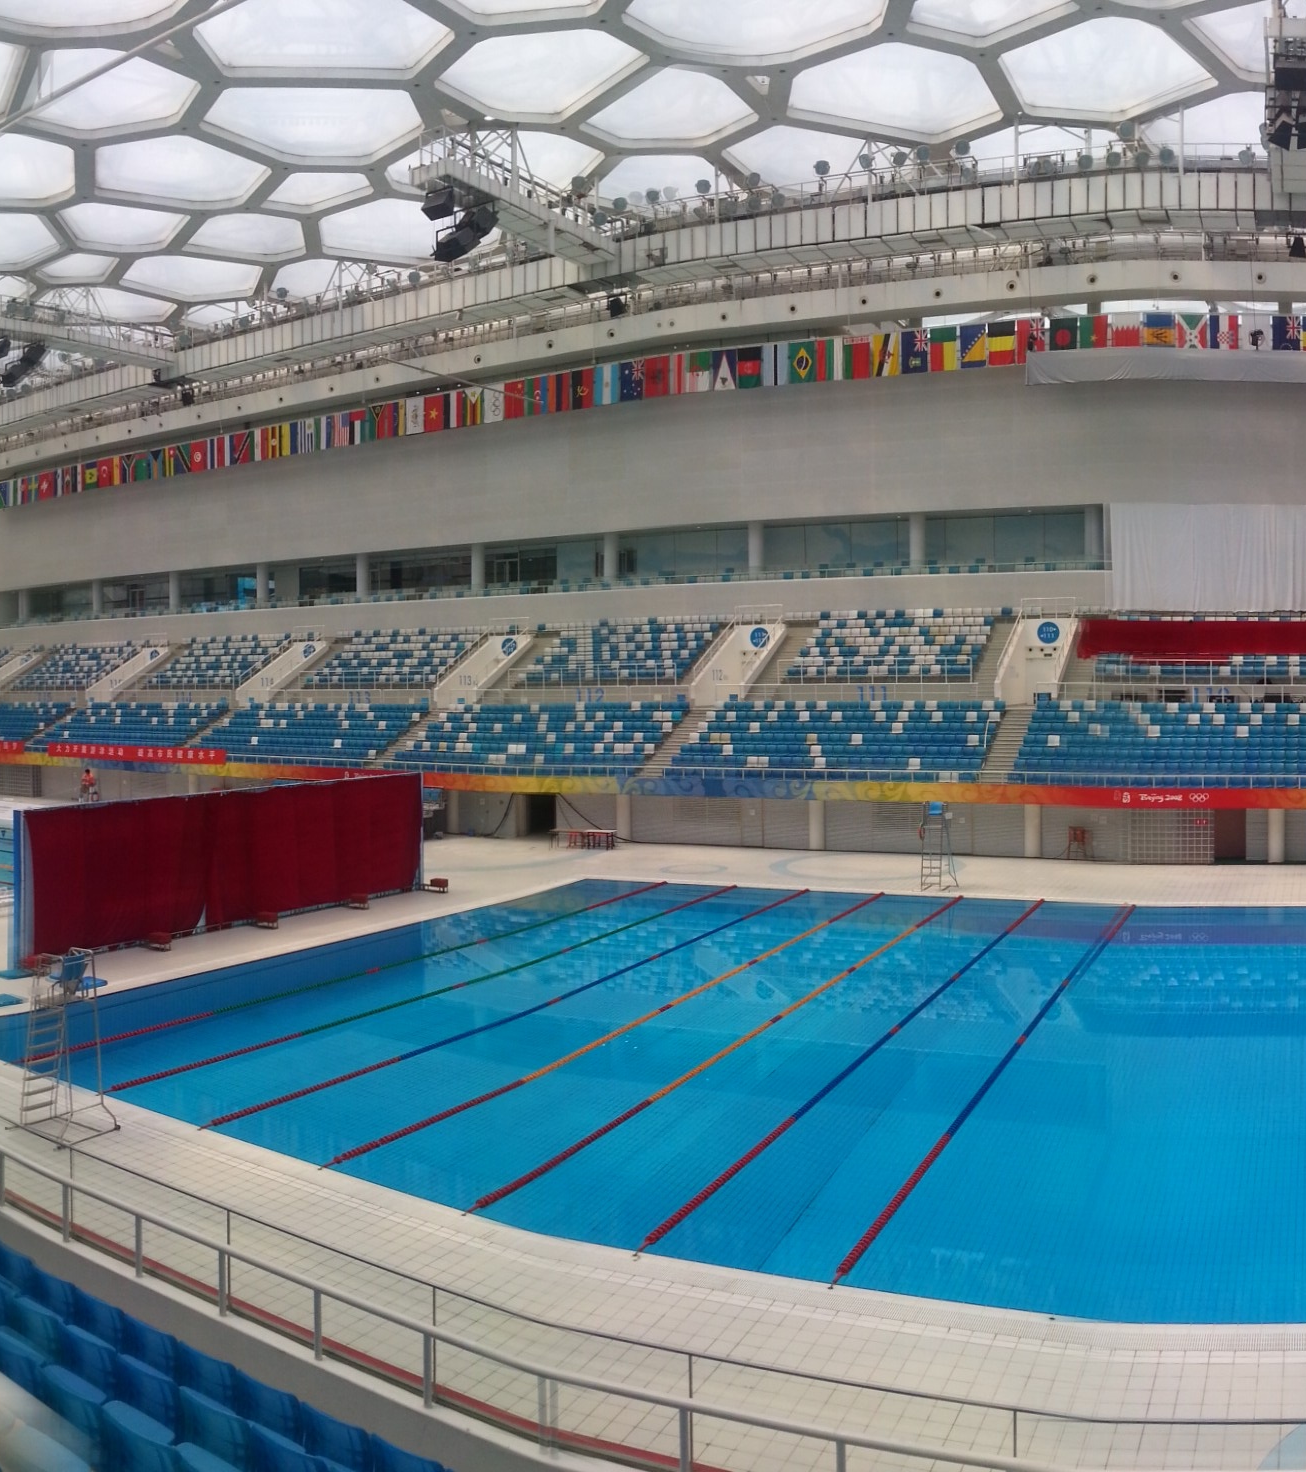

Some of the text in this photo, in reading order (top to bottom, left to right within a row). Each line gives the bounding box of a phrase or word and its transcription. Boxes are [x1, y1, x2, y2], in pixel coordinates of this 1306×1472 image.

[576, 688, 605, 703] 112
[856, 685, 887, 701] 111
[1139, 793, 1164, 803] Beijing
